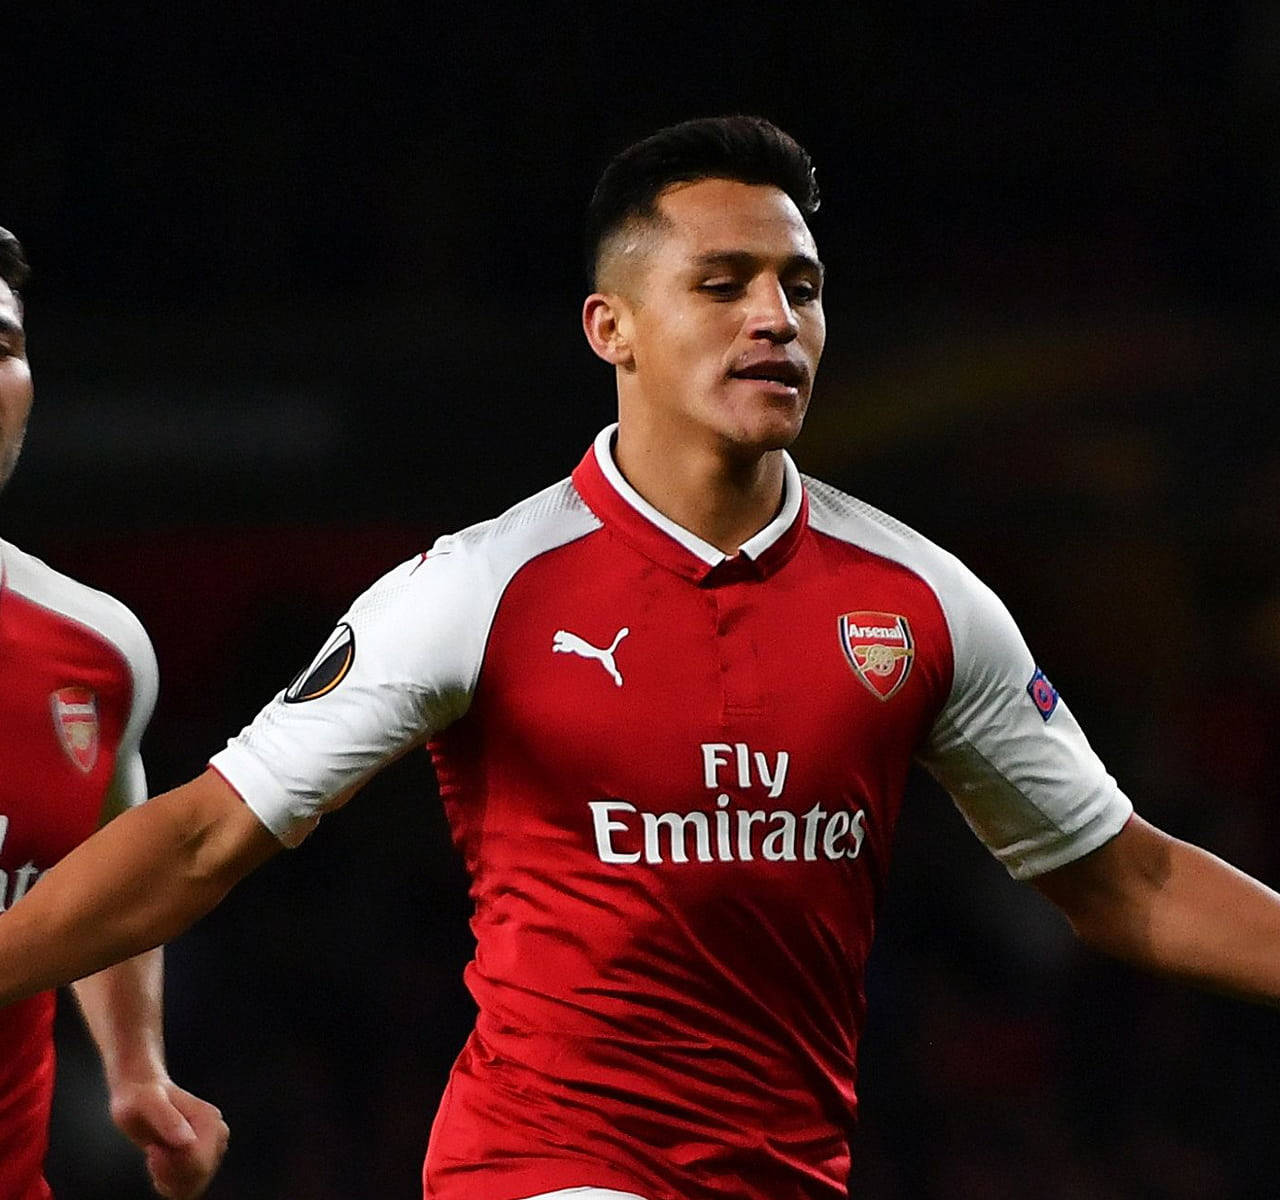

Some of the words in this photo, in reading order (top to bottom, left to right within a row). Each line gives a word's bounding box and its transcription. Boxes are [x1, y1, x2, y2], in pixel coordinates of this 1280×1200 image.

[849, 624, 904, 639] Arsenal
[701, 743, 789, 798] Fly
[588, 794, 866, 864] Emirates
